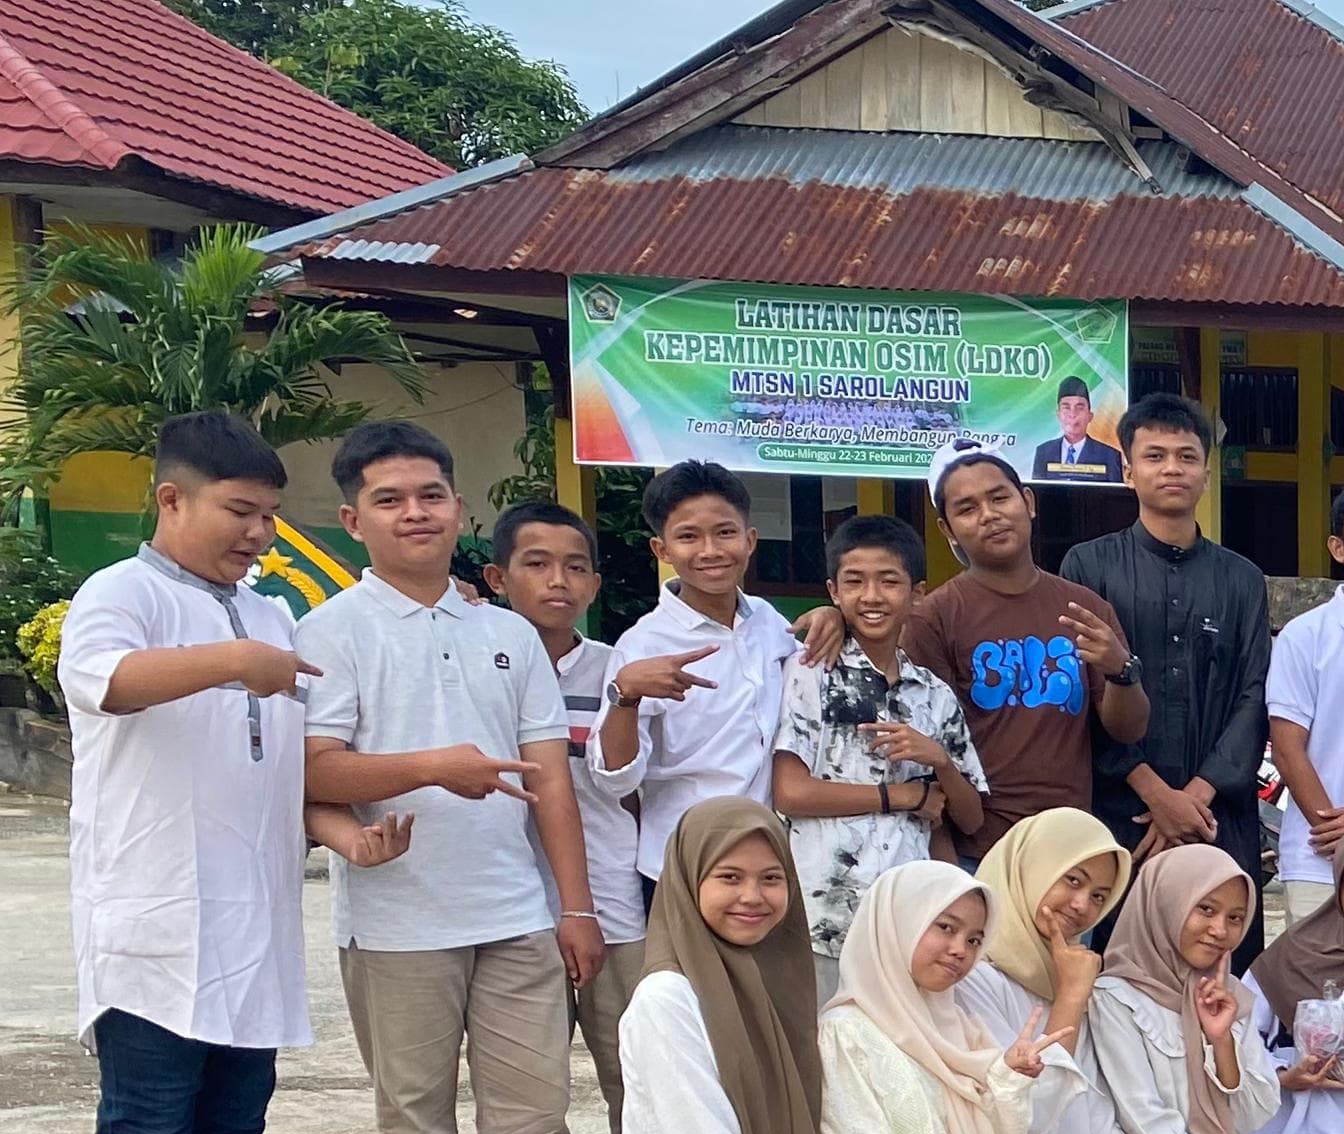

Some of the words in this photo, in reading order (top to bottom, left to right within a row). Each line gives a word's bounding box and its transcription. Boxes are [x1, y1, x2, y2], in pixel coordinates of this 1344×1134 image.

[736, 299, 859, 332] LATIHAN
[867, 305, 962, 337] DASAR
[645, 331, 868, 371] KEPEMIMPINAN
[875, 341, 948, 373] OSIM
[955, 340, 1052, 379] (LDKO)
[731, 370, 796, 395] MTSN
[801, 372, 812, 396] 1
[818, 373, 970, 402] SAROLANGUN
[687, 418, 731, 434] Tema:
[736, 420, 780, 437] Muda
[784, 423, 857, 443] Berkarya,
[765, 447, 836, 462] Sabtu-Minggu
[838, 450, 867, 461] 22-23
[869, 451, 912, 463] Februari
[915, 453, 932, 463] 202
